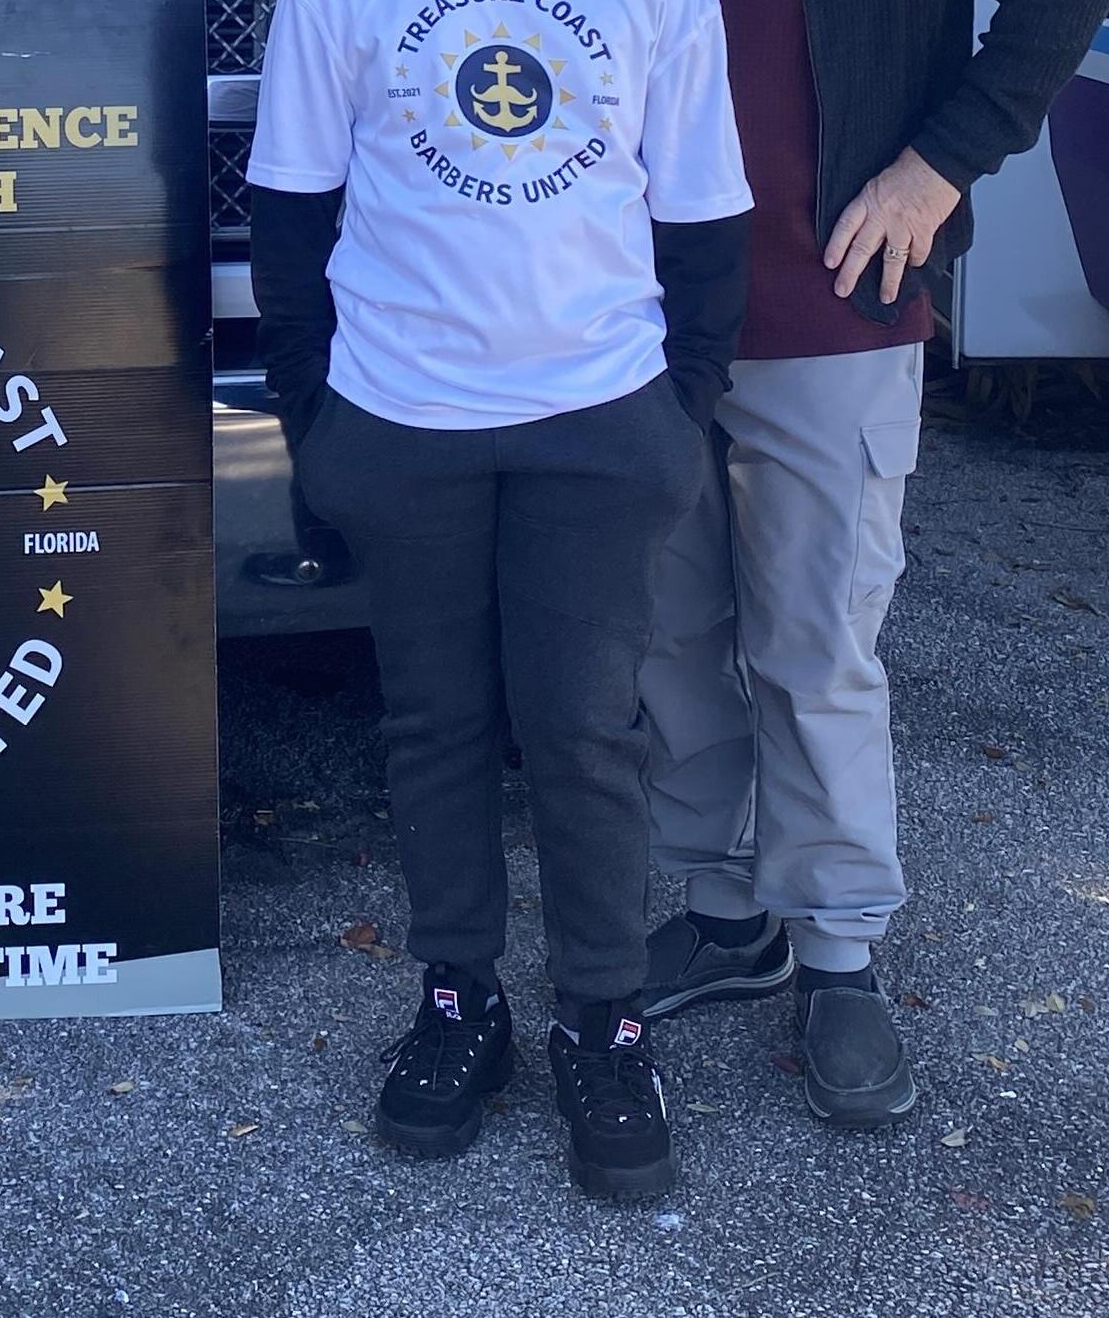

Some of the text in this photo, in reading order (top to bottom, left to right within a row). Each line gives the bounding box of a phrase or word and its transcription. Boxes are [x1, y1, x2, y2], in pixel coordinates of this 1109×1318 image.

[410, 129, 606, 205] BARBERS UNITED
[23, 531, 100, 554] FLORIDA
